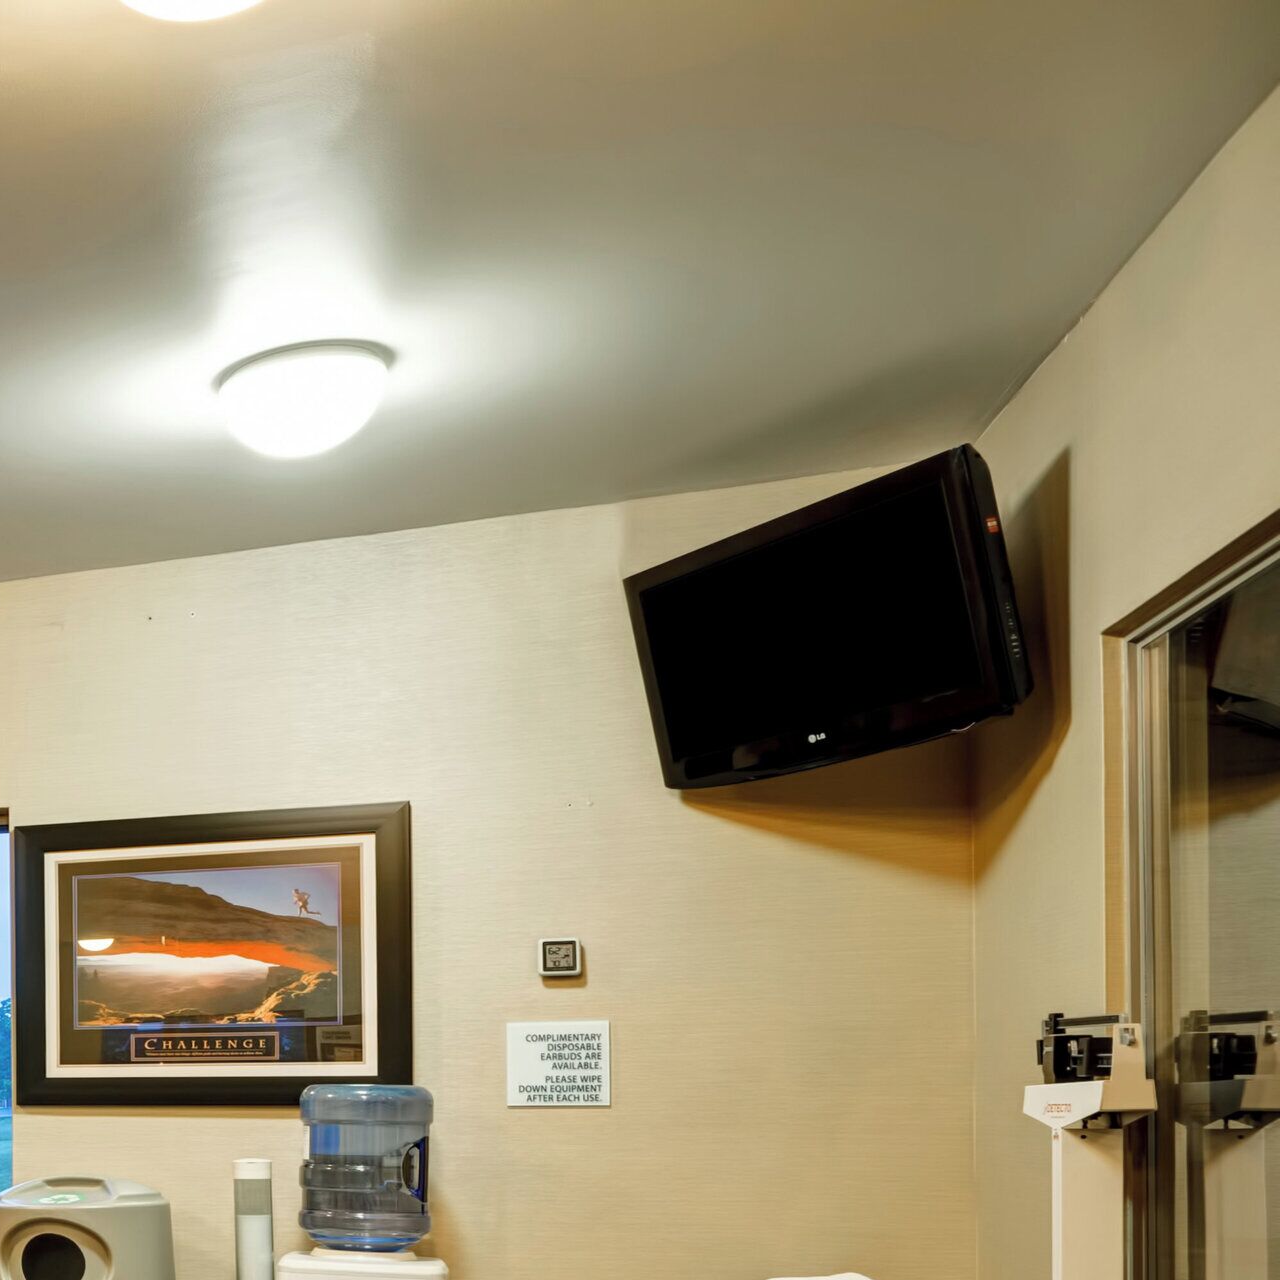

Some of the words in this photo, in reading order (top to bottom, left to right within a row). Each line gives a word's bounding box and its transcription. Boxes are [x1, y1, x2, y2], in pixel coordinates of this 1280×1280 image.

[525, 1033, 602, 1042] COMPLIMENTARY
[144, 1038, 267, 1050] CHALLENGE
[547, 1043, 602, 1051] DISPOSABLE
[540, 1052, 582, 1061] EARBUDS
[584, 1052, 602, 1060] ARE
[551, 1062, 602, 1070] AVAILABLE.
[545, 1075, 577, 1084] PLEASE
[580, 1075, 602, 1083] WIPE
[519, 1085, 547, 1093] DOWN
[550, 1085, 602, 1093] EQUIPMENT
[526, 1094, 554, 1102] AFTER
[556, 1094, 580, 1102] EACH
[582, 1094, 602, 1102] USE.
